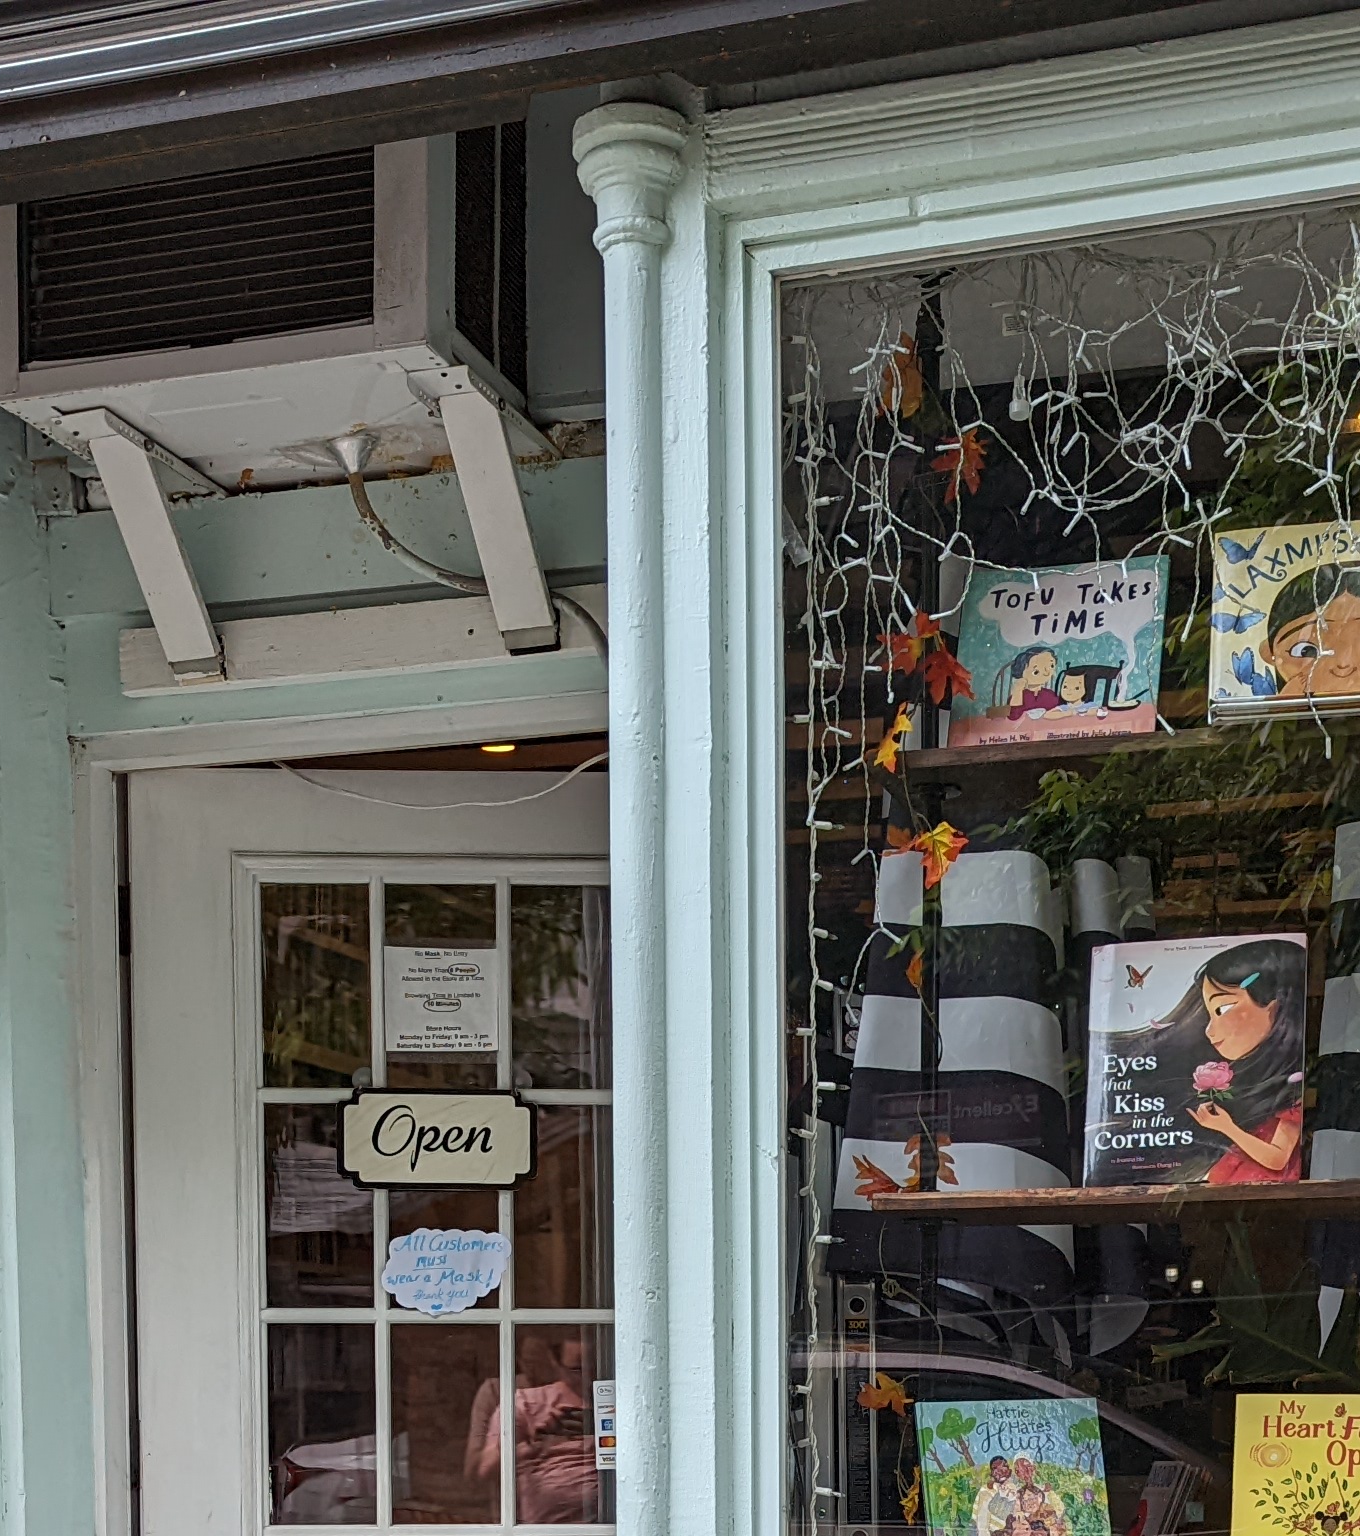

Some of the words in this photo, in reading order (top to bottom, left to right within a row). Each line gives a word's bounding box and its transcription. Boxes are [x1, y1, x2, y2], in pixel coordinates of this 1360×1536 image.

[1102, 1053, 1158, 1078] Eyes
[1102, 1077, 1133, 1092] that
[1113, 1093, 1166, 1115] Kiss
[1131, 1115, 1147, 1129] in
[1149, 1114, 1175, 1128] the
[371, 1103, 493, 1173] Open
[1094, 1129, 1194, 1151] Corners
[394, 1234, 426, 1252] All
[428, 1233, 504, 1253] Customers
[986, 1405, 1031, 1420] Hattie
[1279, 1399, 1307, 1420] My
[1007, 1419, 1054, 1436] Hates
[1262, 1415, 1337, 1439] Heart
[975, 1421, 1057, 1463] Hugs
